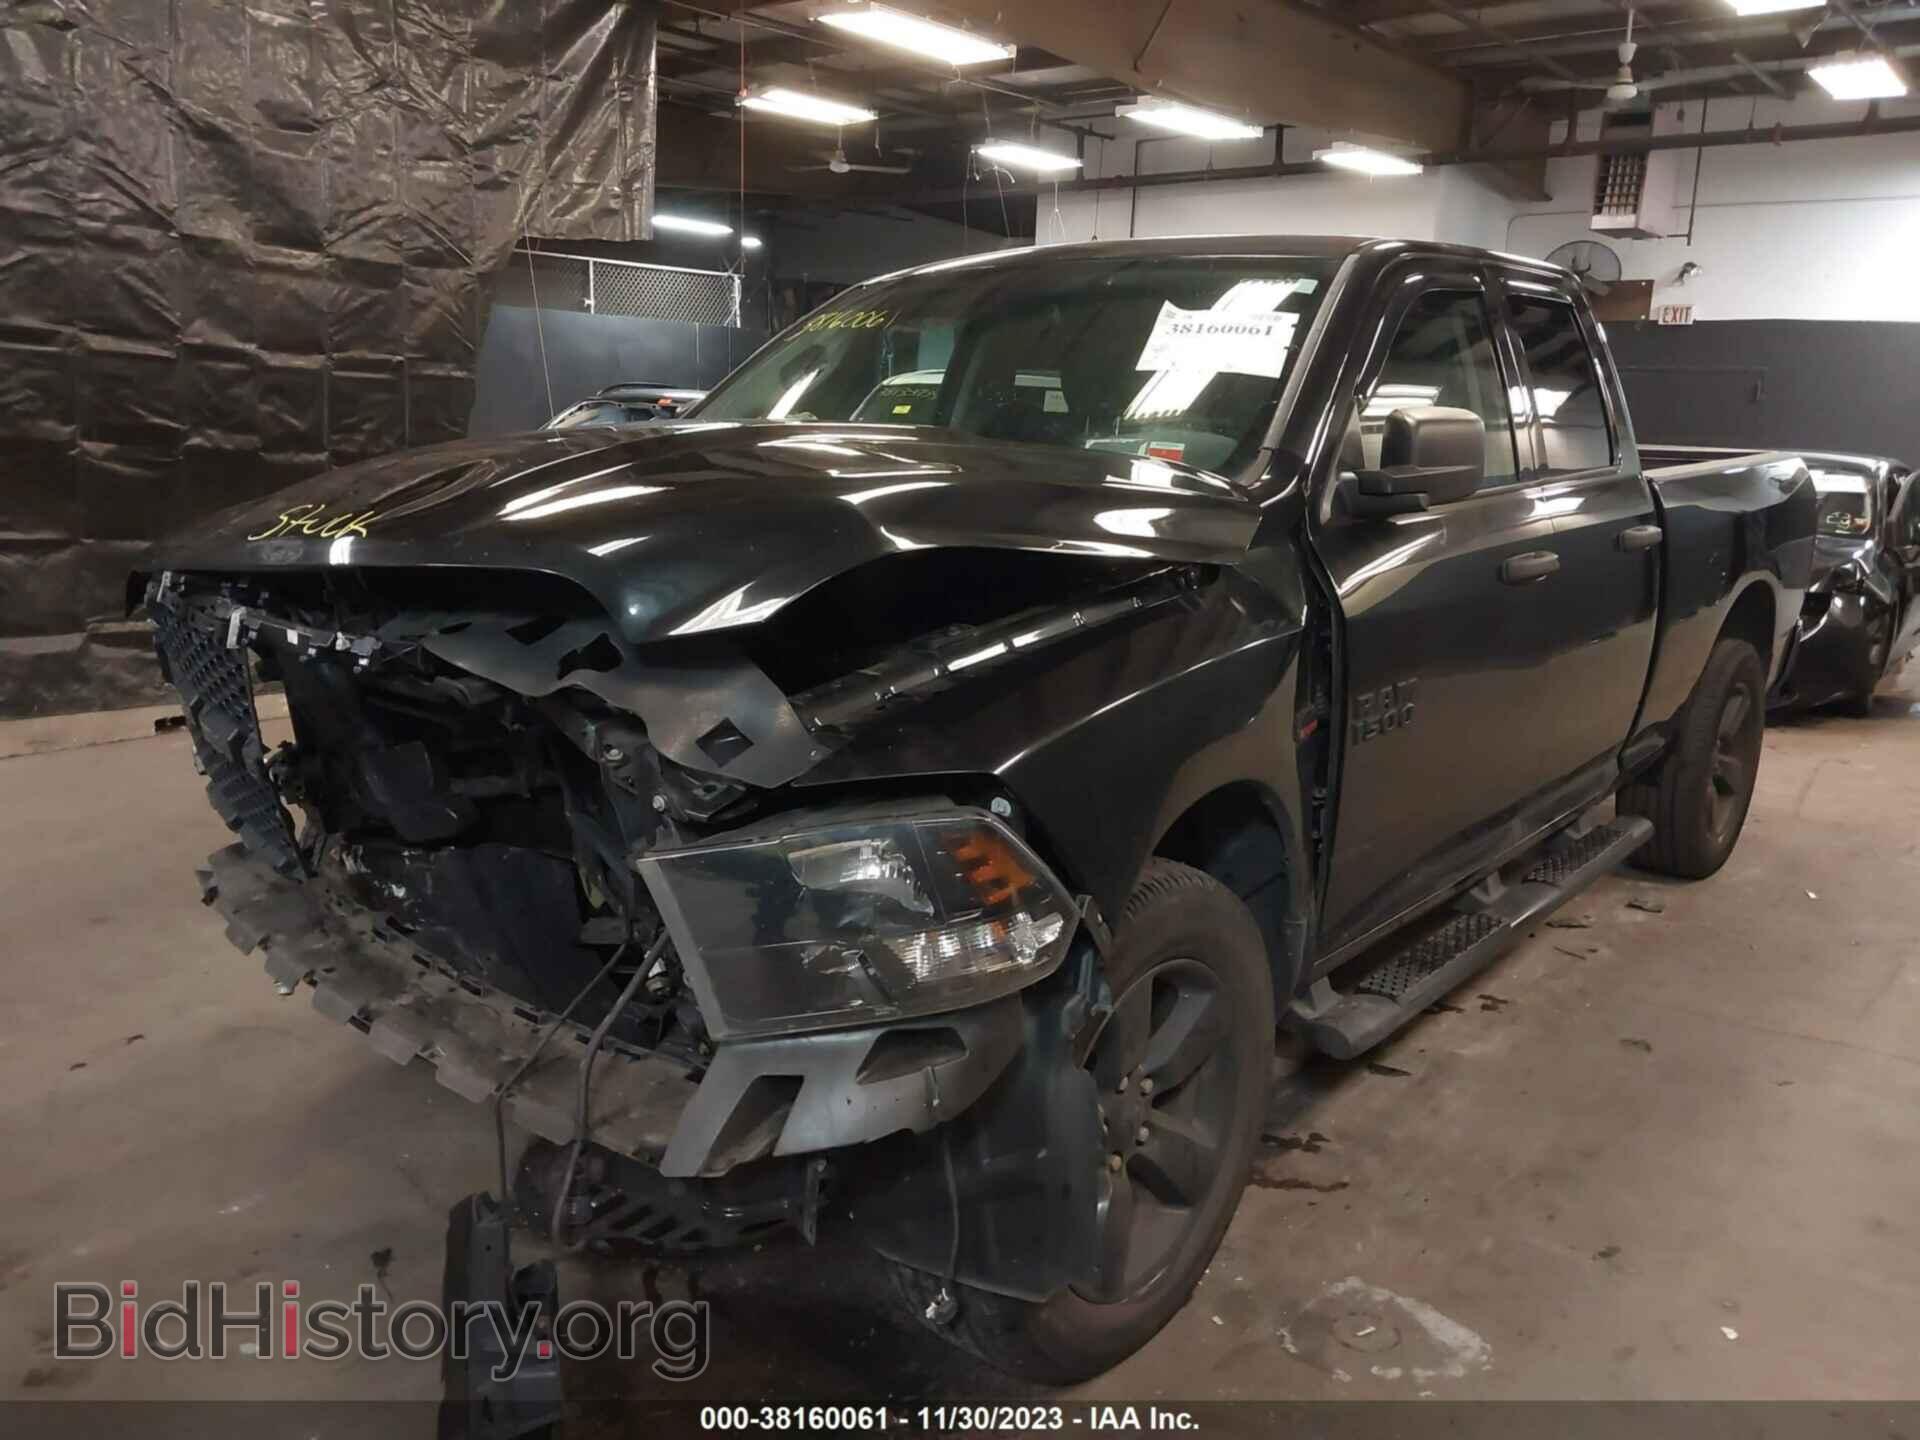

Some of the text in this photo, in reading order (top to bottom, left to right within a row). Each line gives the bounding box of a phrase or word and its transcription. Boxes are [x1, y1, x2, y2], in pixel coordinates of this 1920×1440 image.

[1662, 307, 1692, 323] EXIT
[1168, 323, 1274, 336] 38160061
[1355, 702, 1416, 748] 1500
